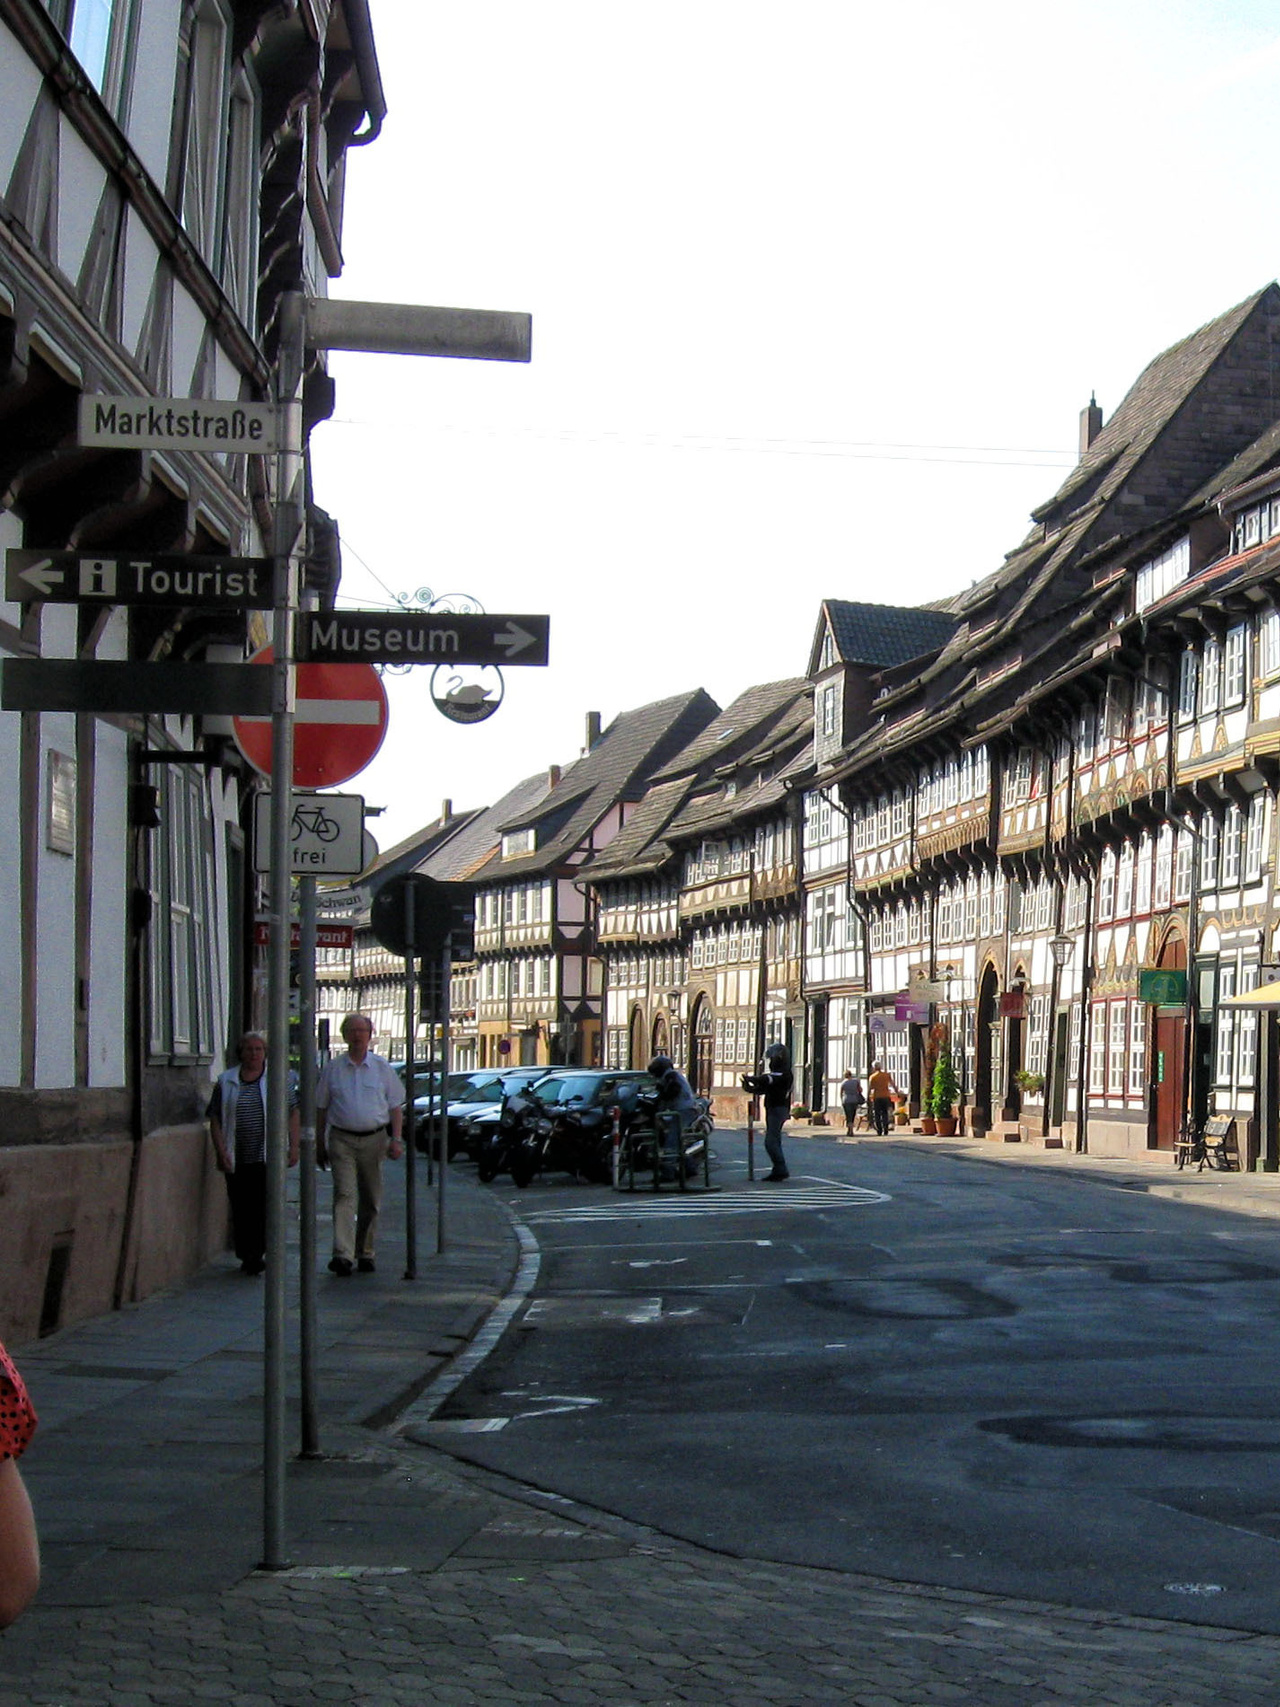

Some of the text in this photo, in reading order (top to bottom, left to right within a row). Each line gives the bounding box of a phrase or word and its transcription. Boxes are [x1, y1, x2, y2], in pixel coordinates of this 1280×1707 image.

[94, 403, 263, 440] Marktstraße
[129, 561, 258, 596] Tourist
[311, 621, 459, 653] Museum
[293, 847, 326, 864] frei
